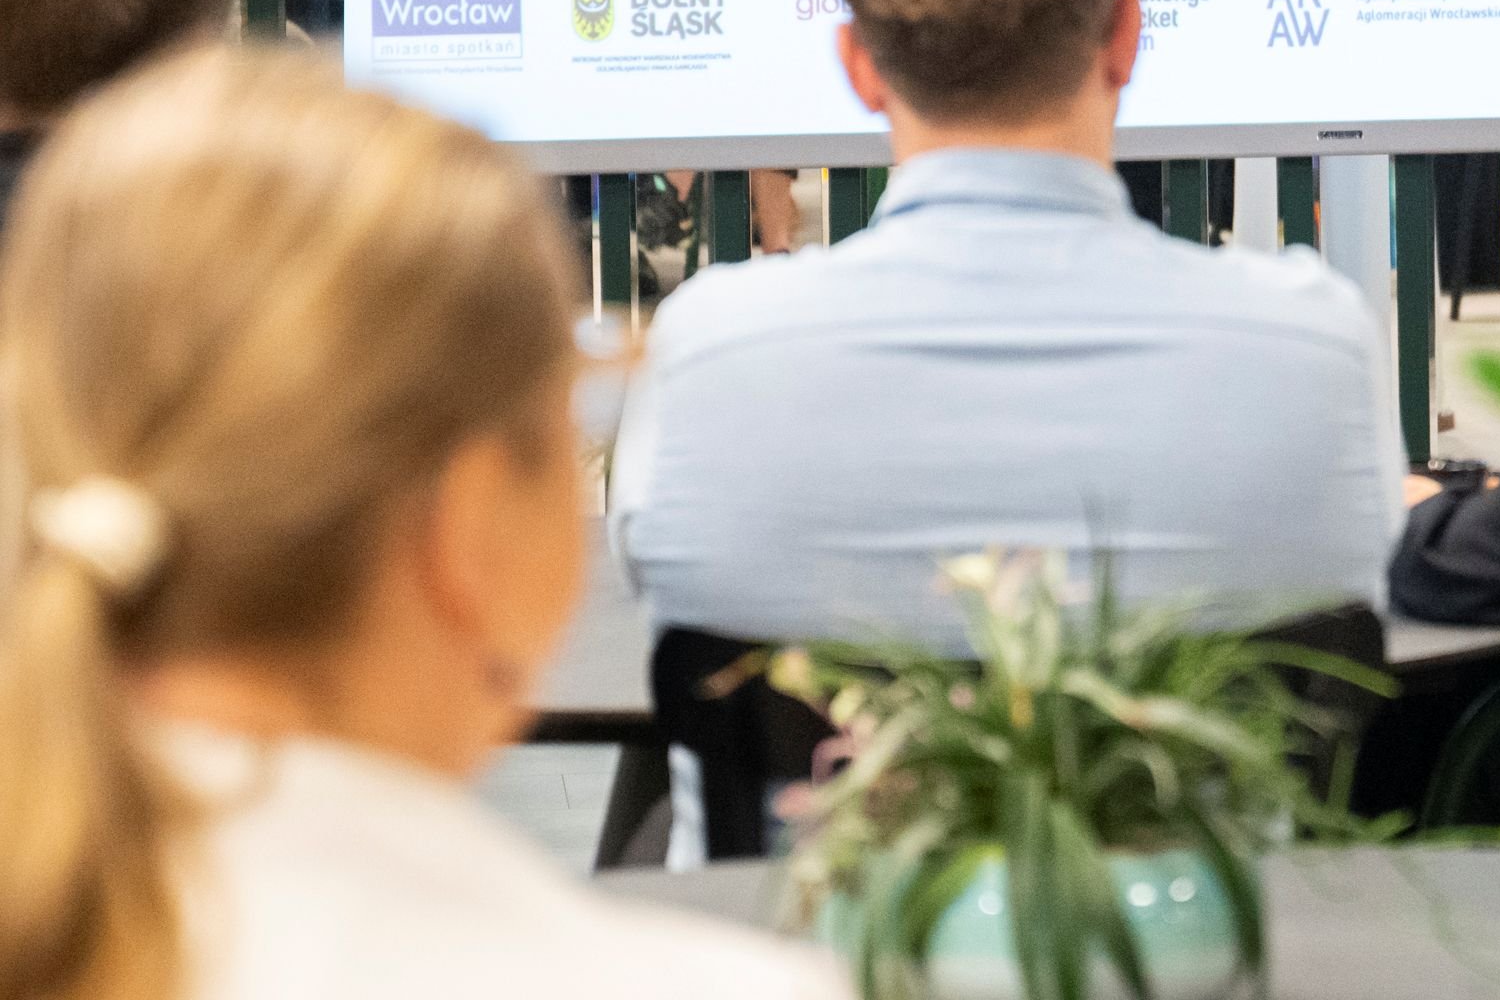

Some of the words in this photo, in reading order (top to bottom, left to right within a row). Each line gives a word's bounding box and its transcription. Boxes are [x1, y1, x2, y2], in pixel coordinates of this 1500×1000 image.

[630, 5, 724, 40] ŚLĄSK
[1356, 7, 1427, 24] Aglomeracji
[380, 41, 440, 56] miasto
[447, 39, 515, 56] spotkań
